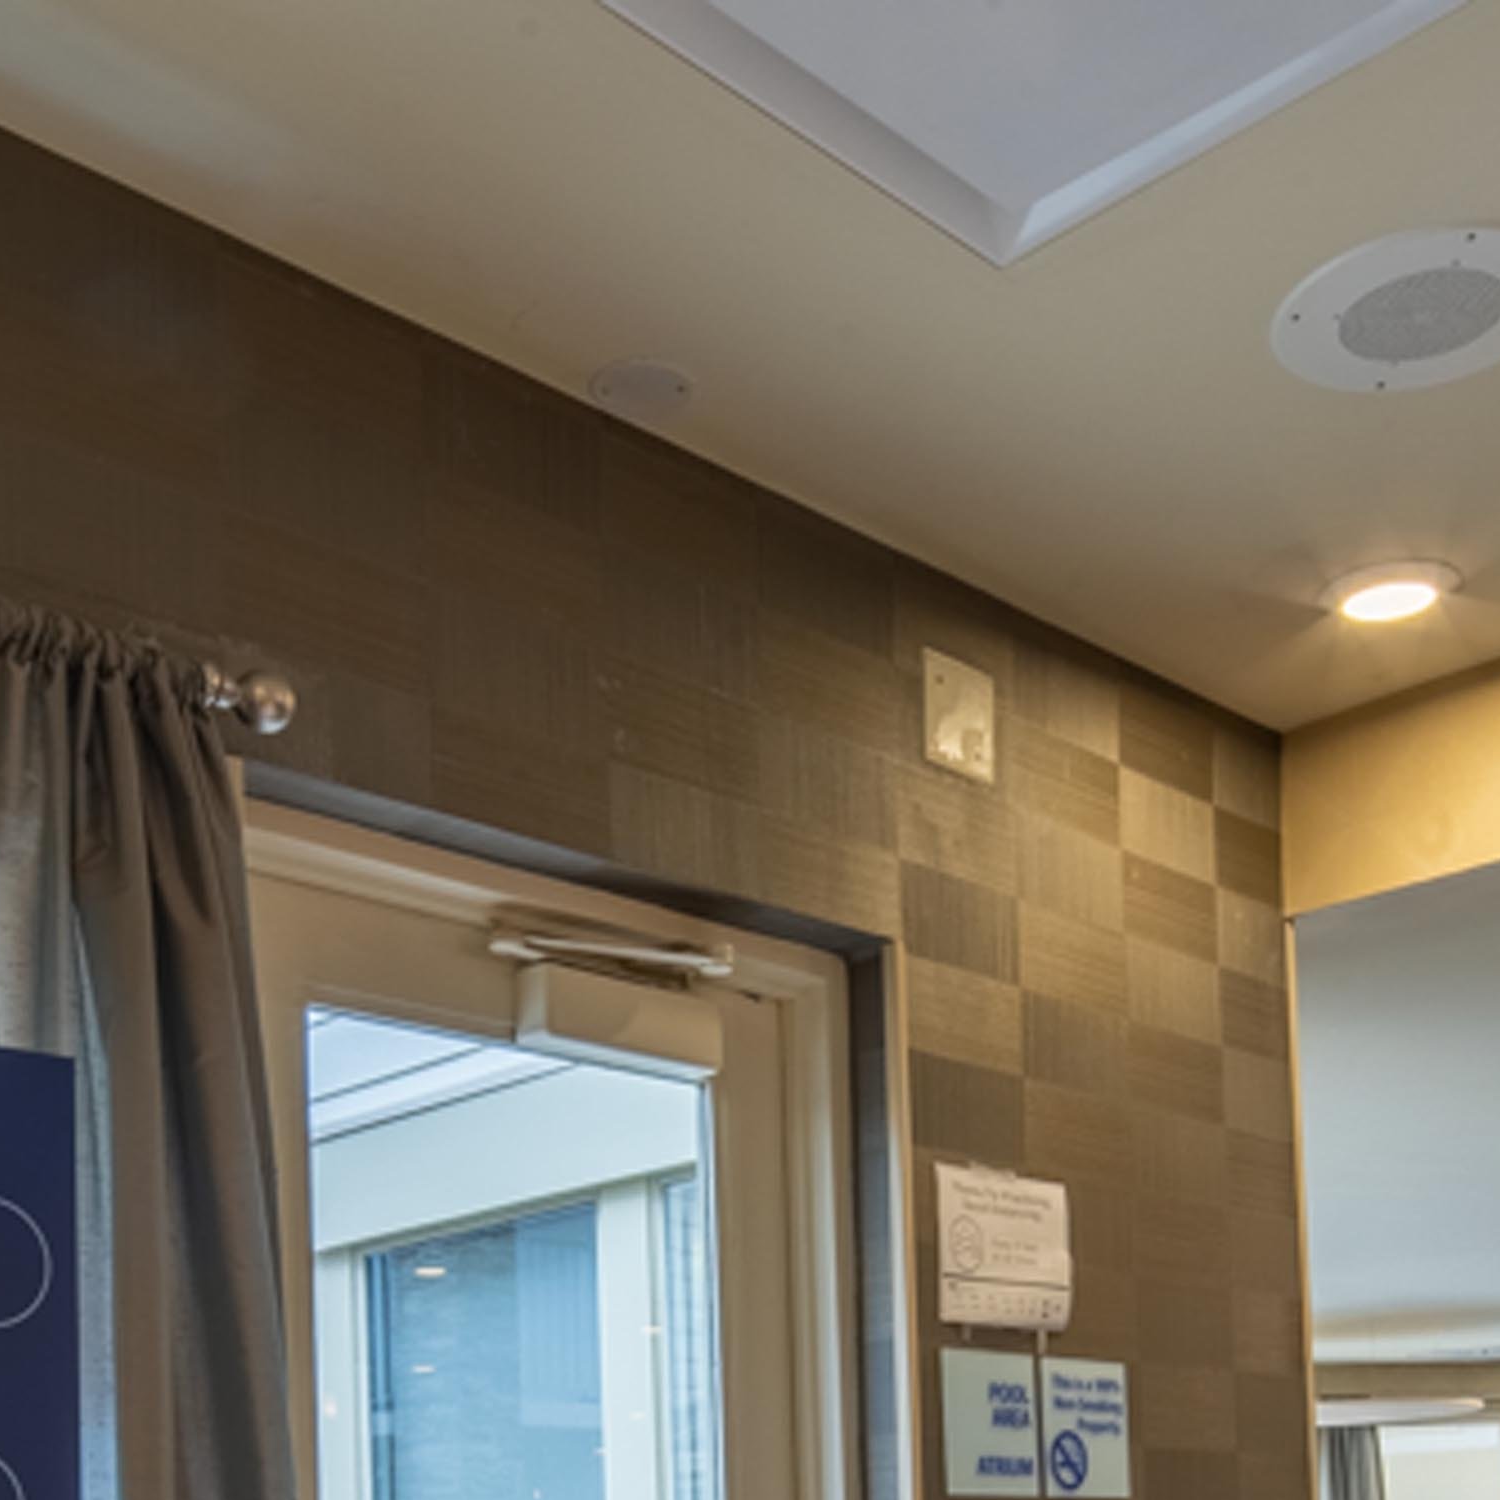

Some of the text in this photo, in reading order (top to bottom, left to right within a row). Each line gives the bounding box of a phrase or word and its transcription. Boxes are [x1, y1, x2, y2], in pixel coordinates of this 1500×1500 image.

[988, 1382, 1030, 1404] POOL
[992, 1408, 1031, 1429] AREA
[976, 1456, 1034, 1476] ATRIUM
